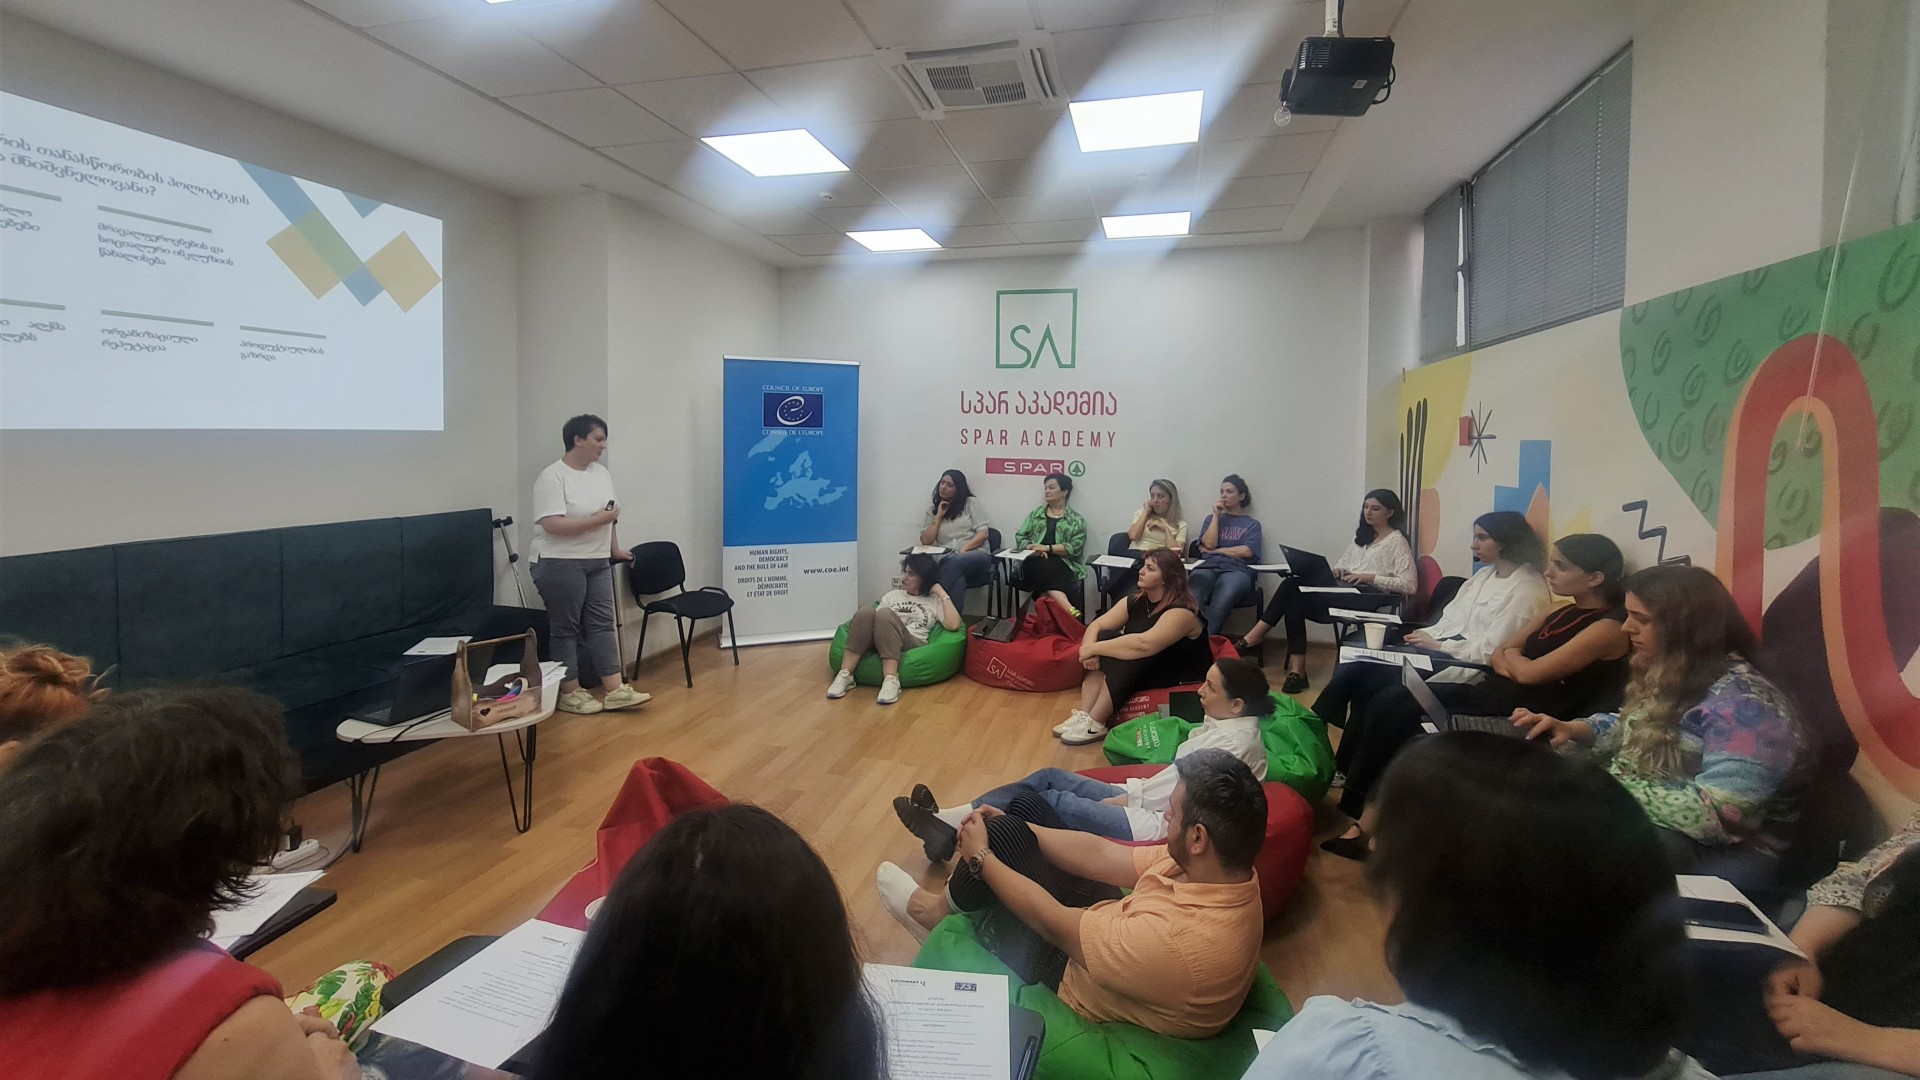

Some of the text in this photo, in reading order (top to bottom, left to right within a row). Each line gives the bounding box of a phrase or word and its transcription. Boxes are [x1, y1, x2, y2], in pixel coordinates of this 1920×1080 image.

[11, 153, 156, 196] მნიშვნელოვანი?
[36, 146, 164, 184] თანასწორობის
[167, 176, 250, 205] პოლიტიკის
[98, 234, 171, 254] სოციალური
[101, 327, 199, 344] ორგანიზაციული
[101, 339, 167, 353] რეპუტაცია
[960, 390, 1118, 416] სპარ აკადემია
[960, 428, 1116, 447] SPAR ACADEMY
[1003, 461, 1064, 474] SPAR
[803, 566, 849, 574] www.coe.int
[757, 582, 789, 590] DÉMOCRATIE
